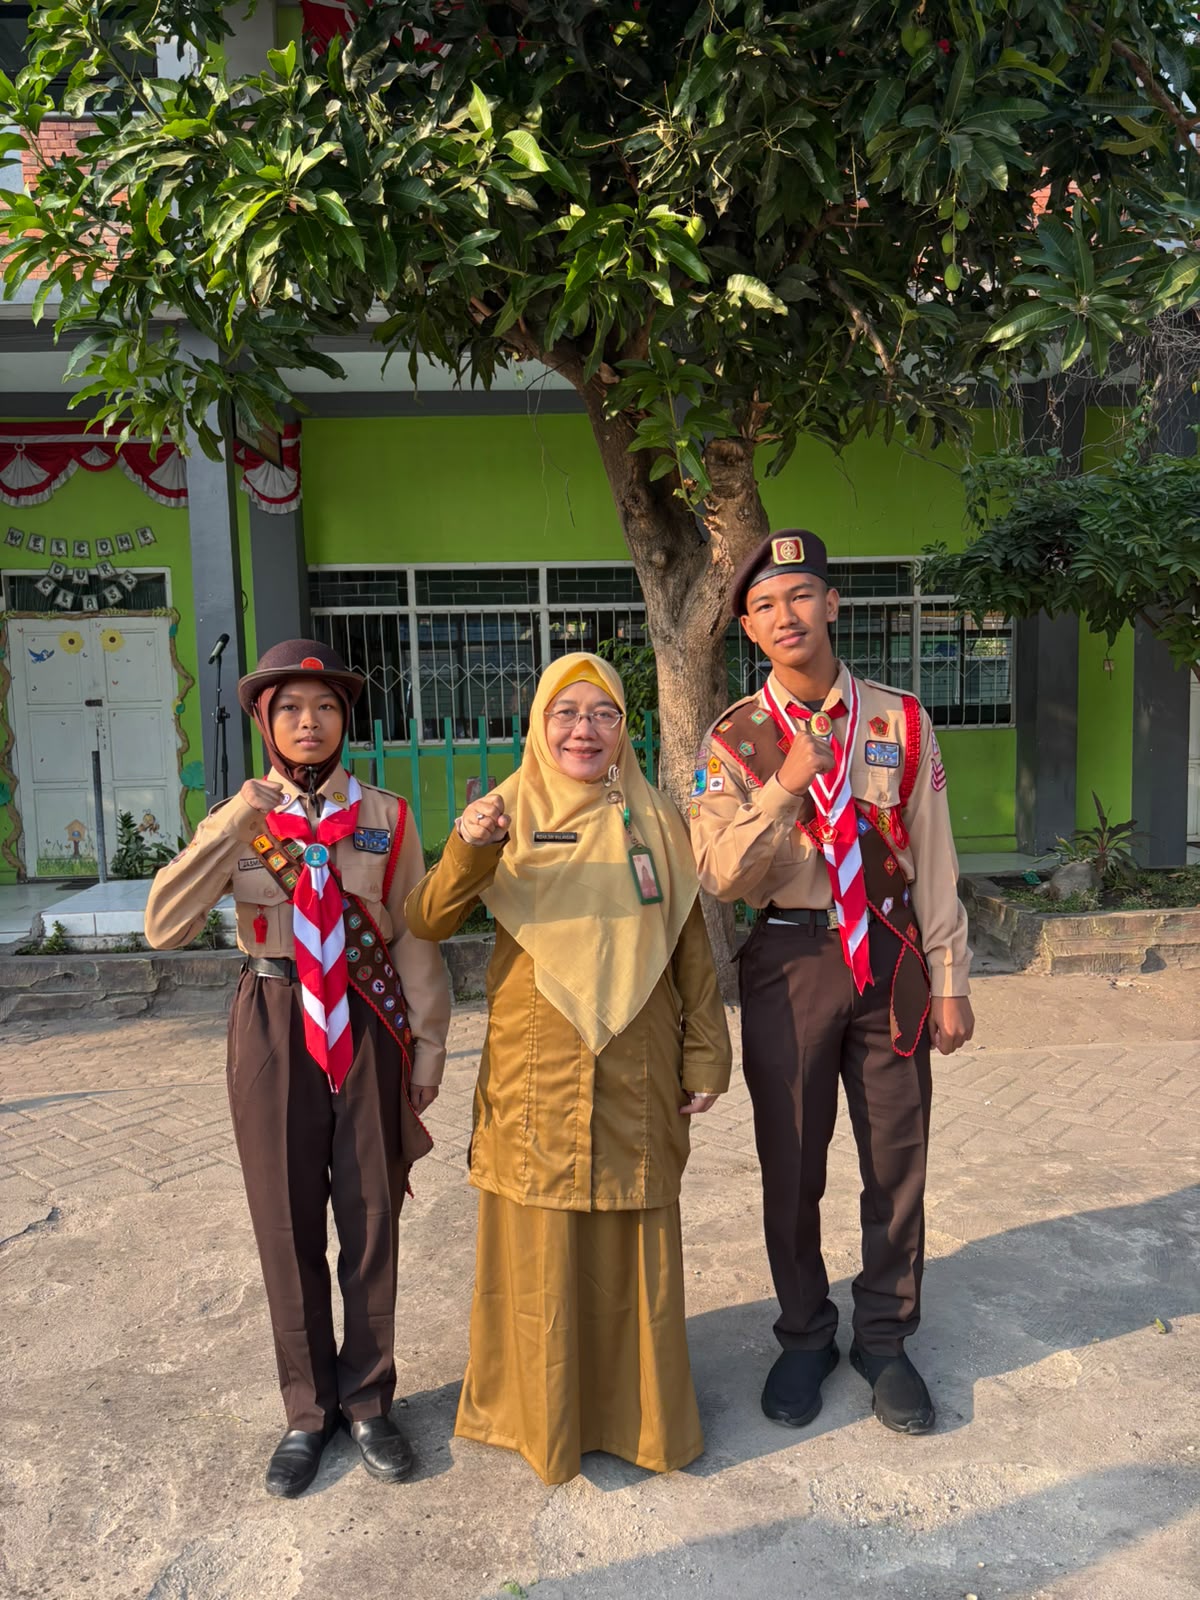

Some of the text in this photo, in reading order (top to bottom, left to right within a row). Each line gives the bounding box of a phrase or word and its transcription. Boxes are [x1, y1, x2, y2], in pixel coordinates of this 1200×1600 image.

[7, 528, 152, 555] WELCOME
[52, 563, 112, 582] OUR
[40, 573, 135, 608] CLASS
